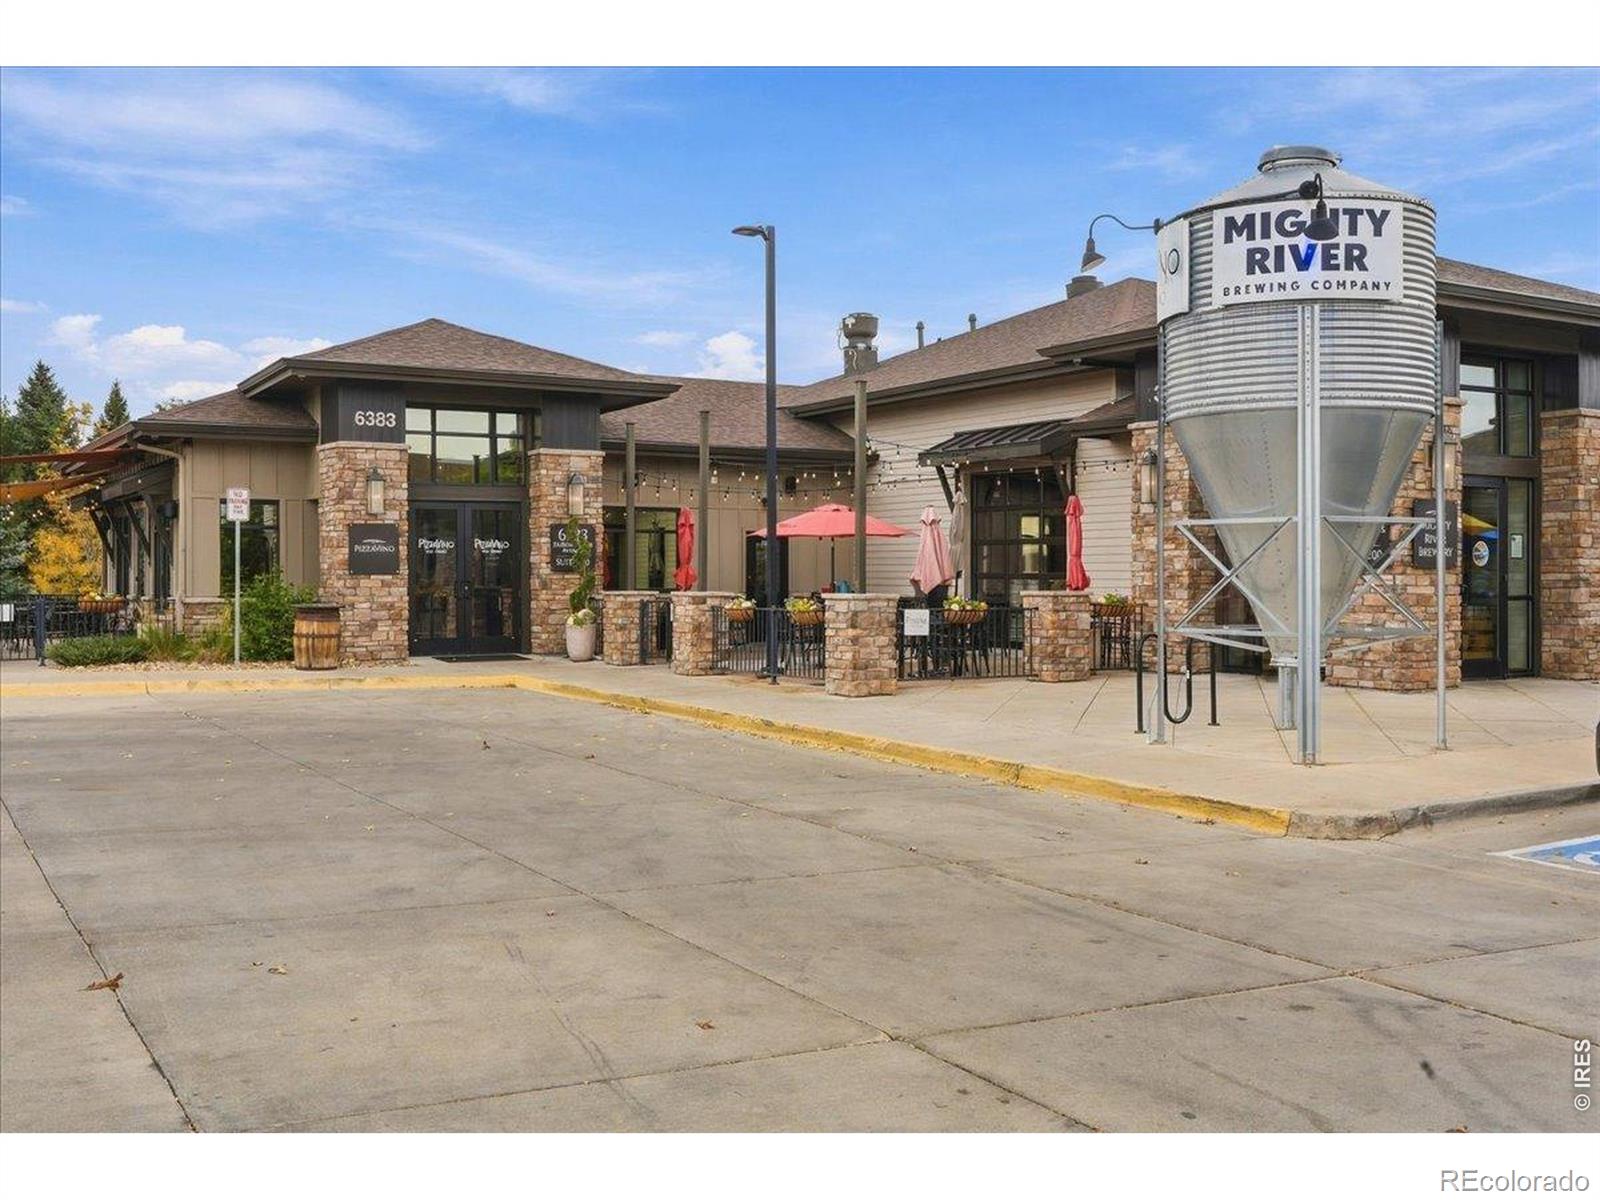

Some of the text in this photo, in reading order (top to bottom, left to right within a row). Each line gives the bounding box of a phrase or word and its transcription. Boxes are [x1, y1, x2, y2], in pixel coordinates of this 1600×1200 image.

[1246, 243, 1369, 275] RIVER
[1223, 279, 1392, 297] BREWING COMPANY
[354, 411, 396, 427] 6383
[1425, 533, 1446, 544] RIVR
[1418, 547, 1453, 557] BRERY
